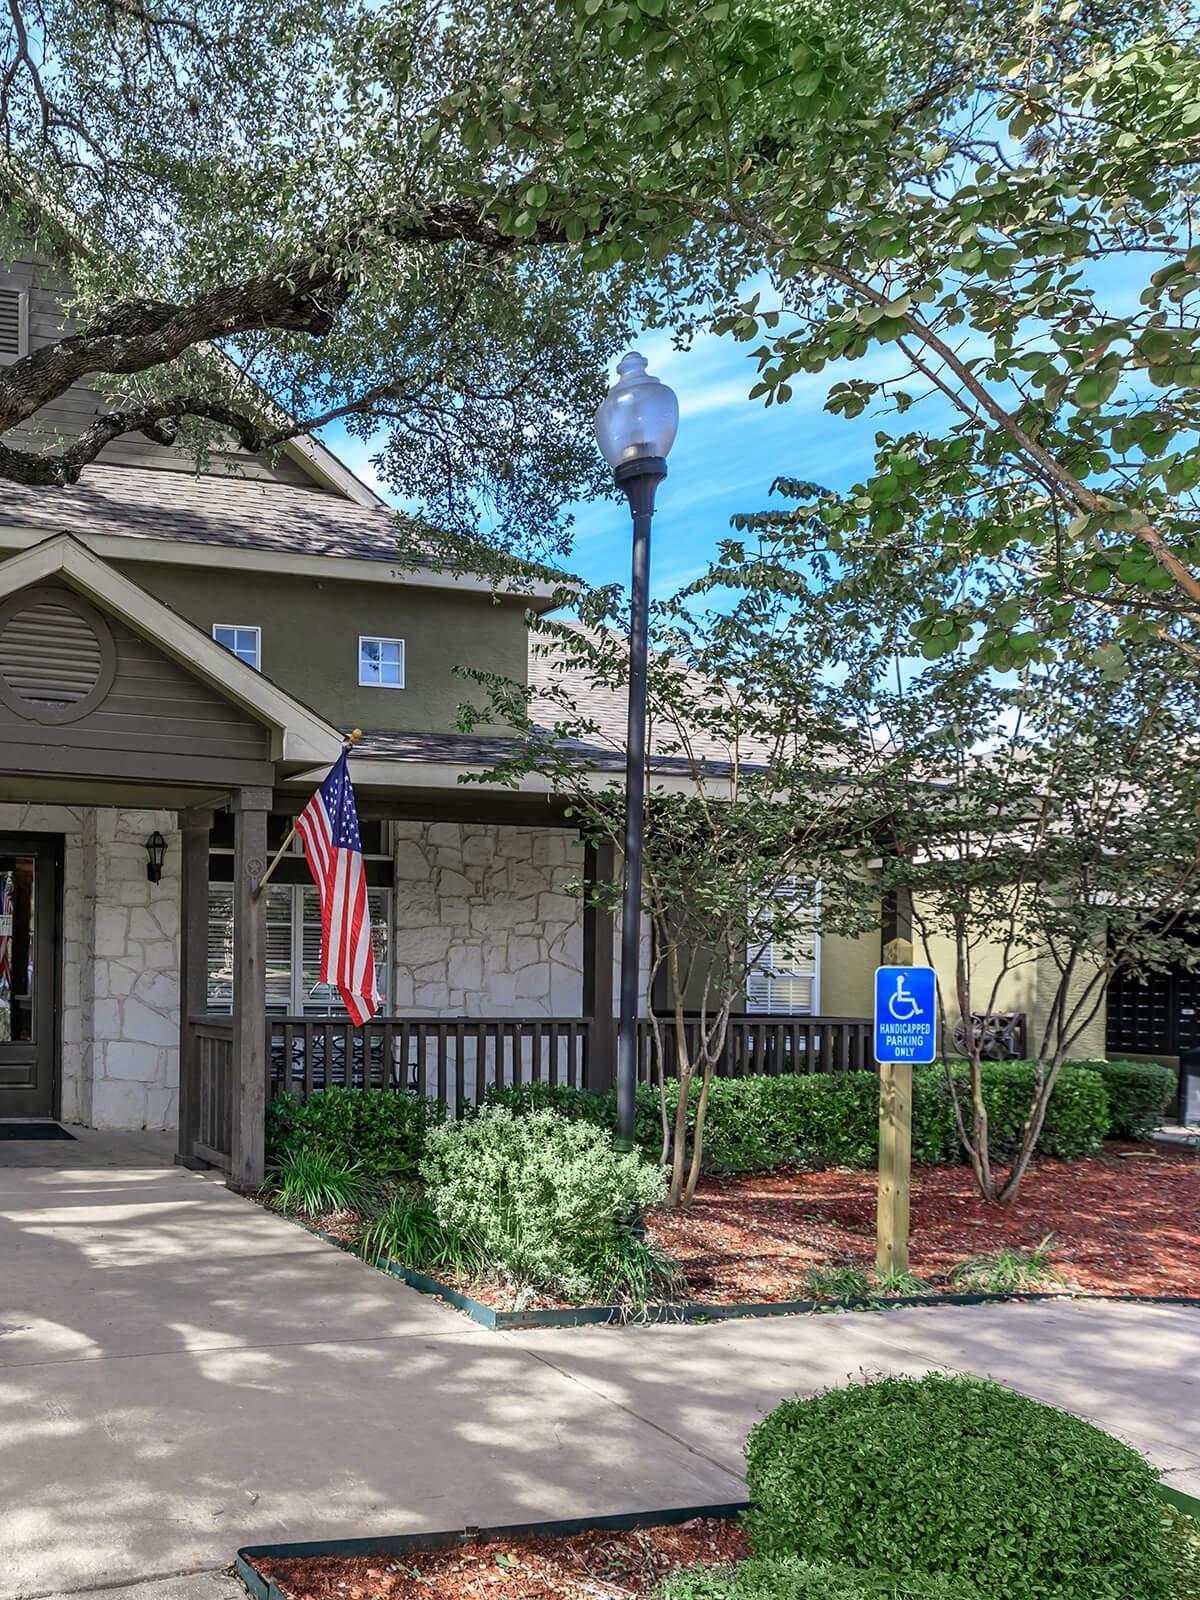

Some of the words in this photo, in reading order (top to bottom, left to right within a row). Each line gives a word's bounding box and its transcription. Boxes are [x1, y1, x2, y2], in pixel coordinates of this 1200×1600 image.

[880, 1023, 930, 1034] HANDICAPPED
[886, 1035, 924, 1046] PARKING
[894, 1047, 915, 1057] ONLY
